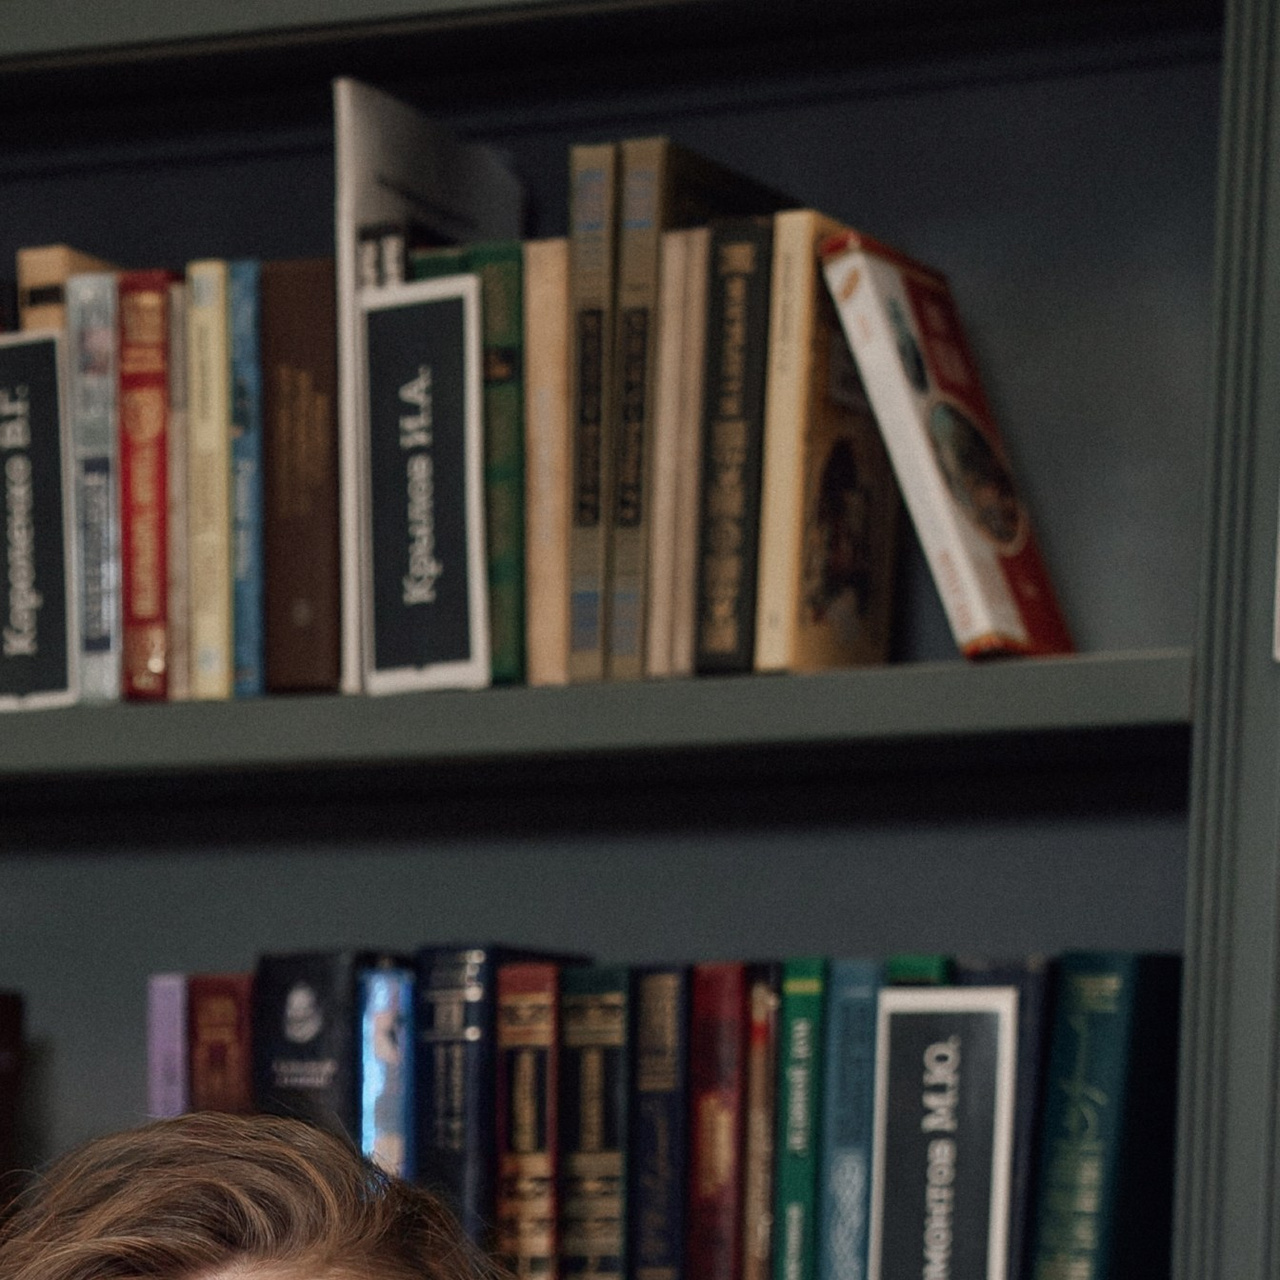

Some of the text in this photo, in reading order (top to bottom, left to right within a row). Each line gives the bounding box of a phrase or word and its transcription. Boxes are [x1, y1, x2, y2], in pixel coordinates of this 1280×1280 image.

[2, 455, 43, 657] Короленко
[402, 454, 442, 605] Крылов
[921, 1032, 962, 1132] М.Ю.
